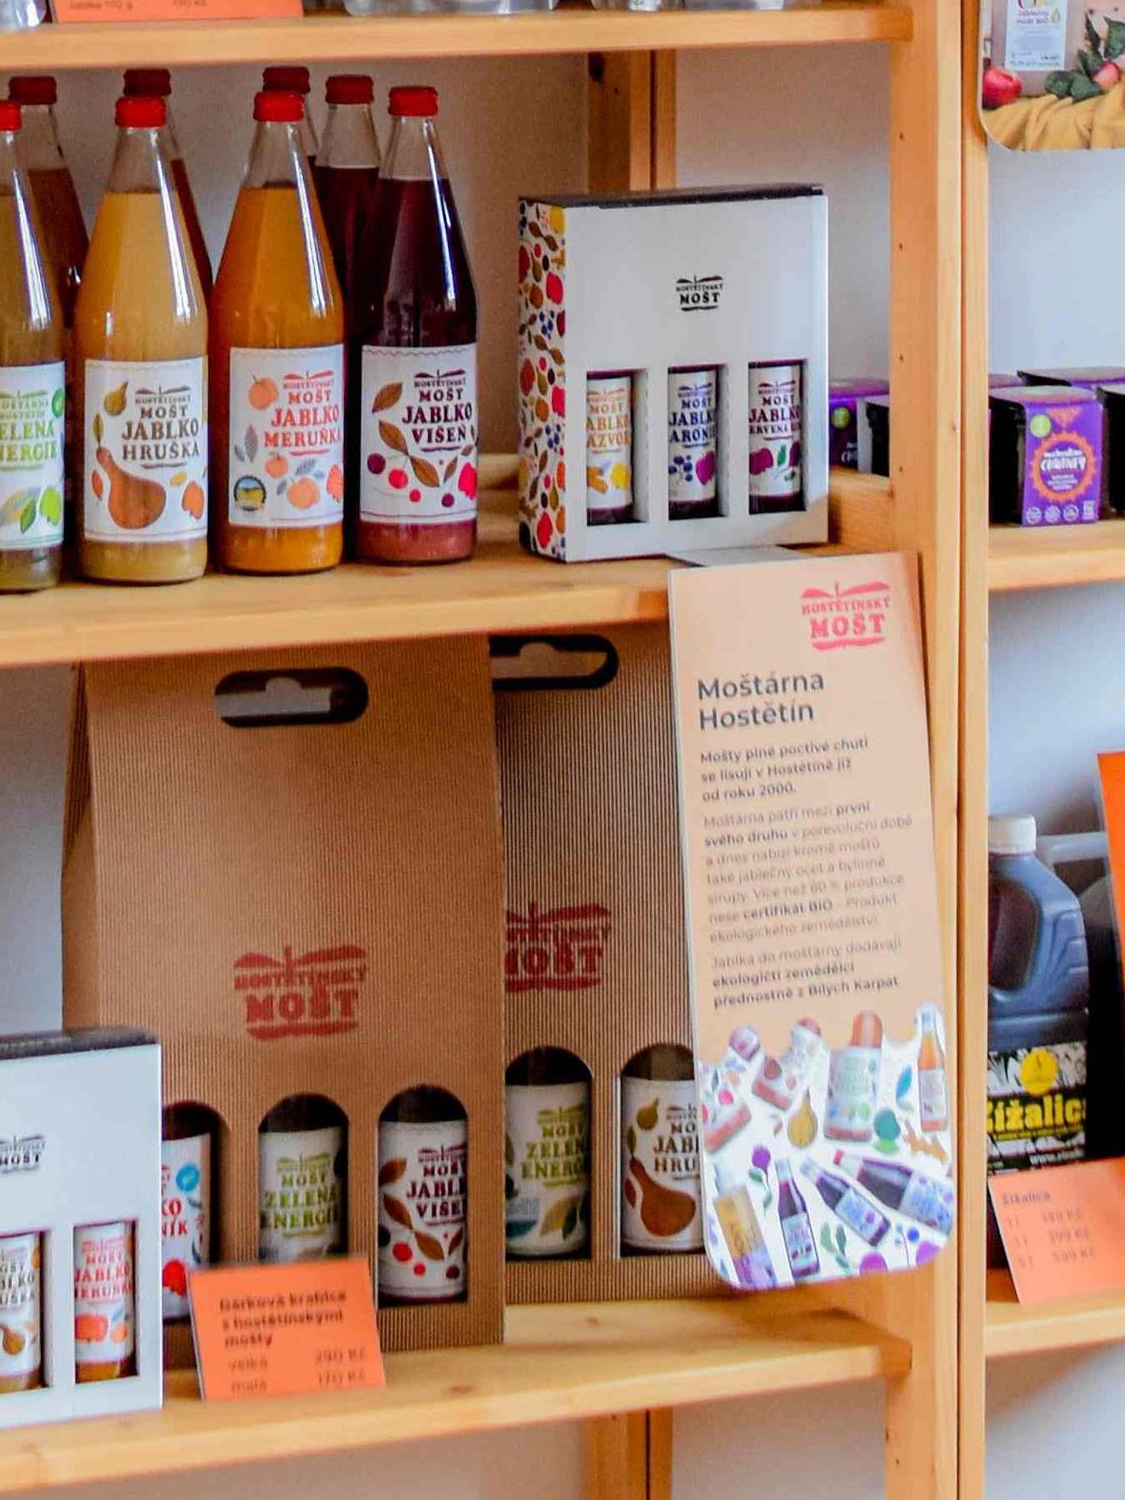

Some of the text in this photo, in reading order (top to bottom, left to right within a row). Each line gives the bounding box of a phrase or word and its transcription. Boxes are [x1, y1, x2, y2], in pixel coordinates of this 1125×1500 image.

[679, 292, 720, 306] MOŠT
[288, 389, 331, 404] MOŠT
[419, 388, 463, 402] MOŠT
[681, 398, 712, 409] MOŠT
[762, 395, 795, 407] MOŠT
[140, 404, 188, 419] MOŠT
[271, 405, 340, 427] JABLKO
[402, 402, 472, 425] JABLKO
[122, 418, 199, 441] JABLKO
[411, 425, 467, 444] VIŠEŇ
[122, 438, 200, 460] HRUŠKA
[810, 612, 885, 638] MOŠT
[698, 671, 825, 700] Moštárna
[699, 698, 815, 730] Hostětín
[245, 986, 359, 1023] MOŠT
[416, 1202, 461, 1219] VIŠE
